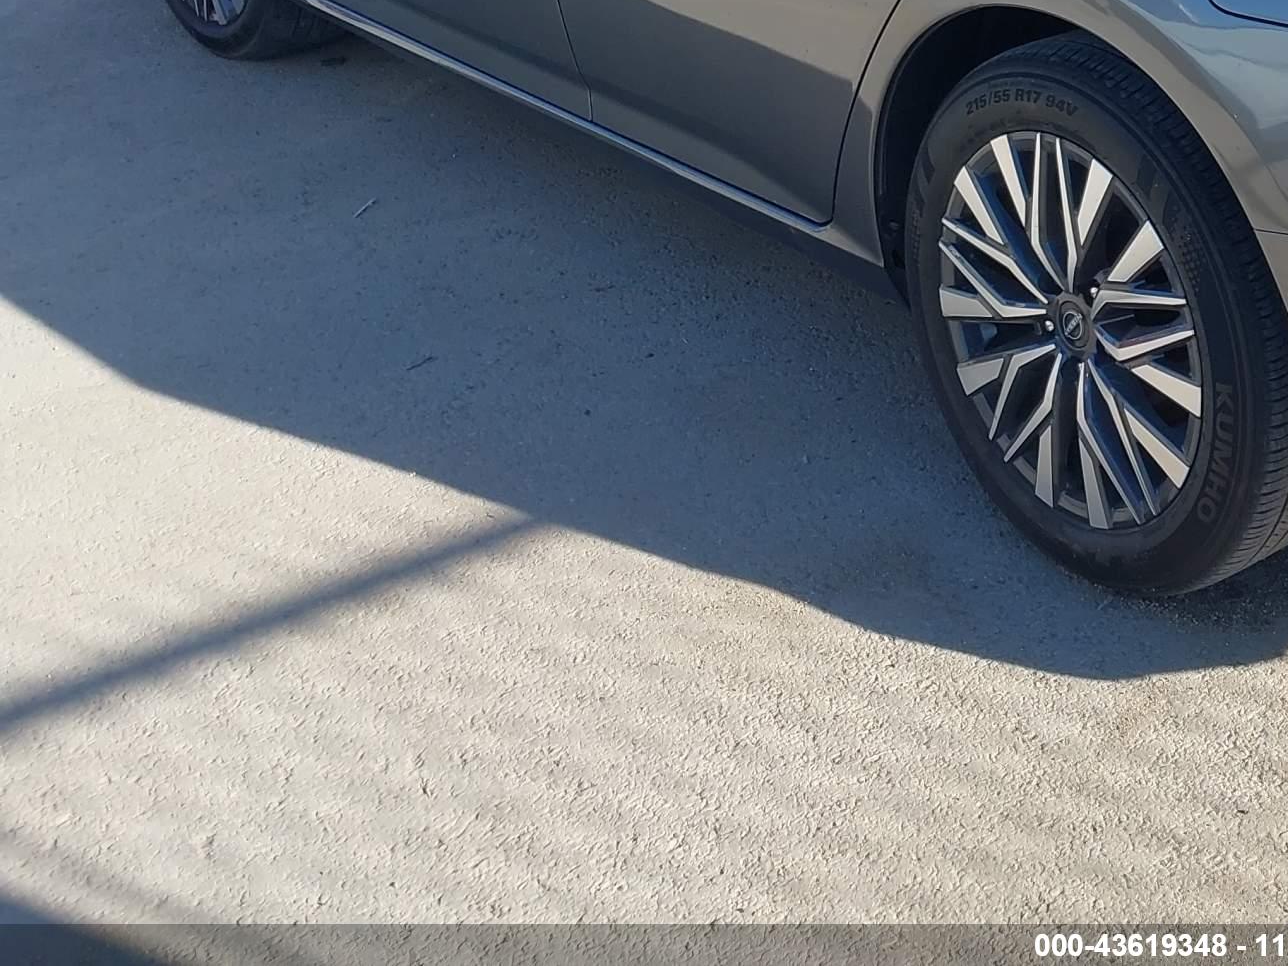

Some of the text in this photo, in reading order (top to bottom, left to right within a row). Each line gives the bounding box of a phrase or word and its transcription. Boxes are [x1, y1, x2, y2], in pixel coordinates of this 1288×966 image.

[966, 89, 1079, 116] 215/55 R17 94V
[1197, 382, 1234, 523] KUMHO
